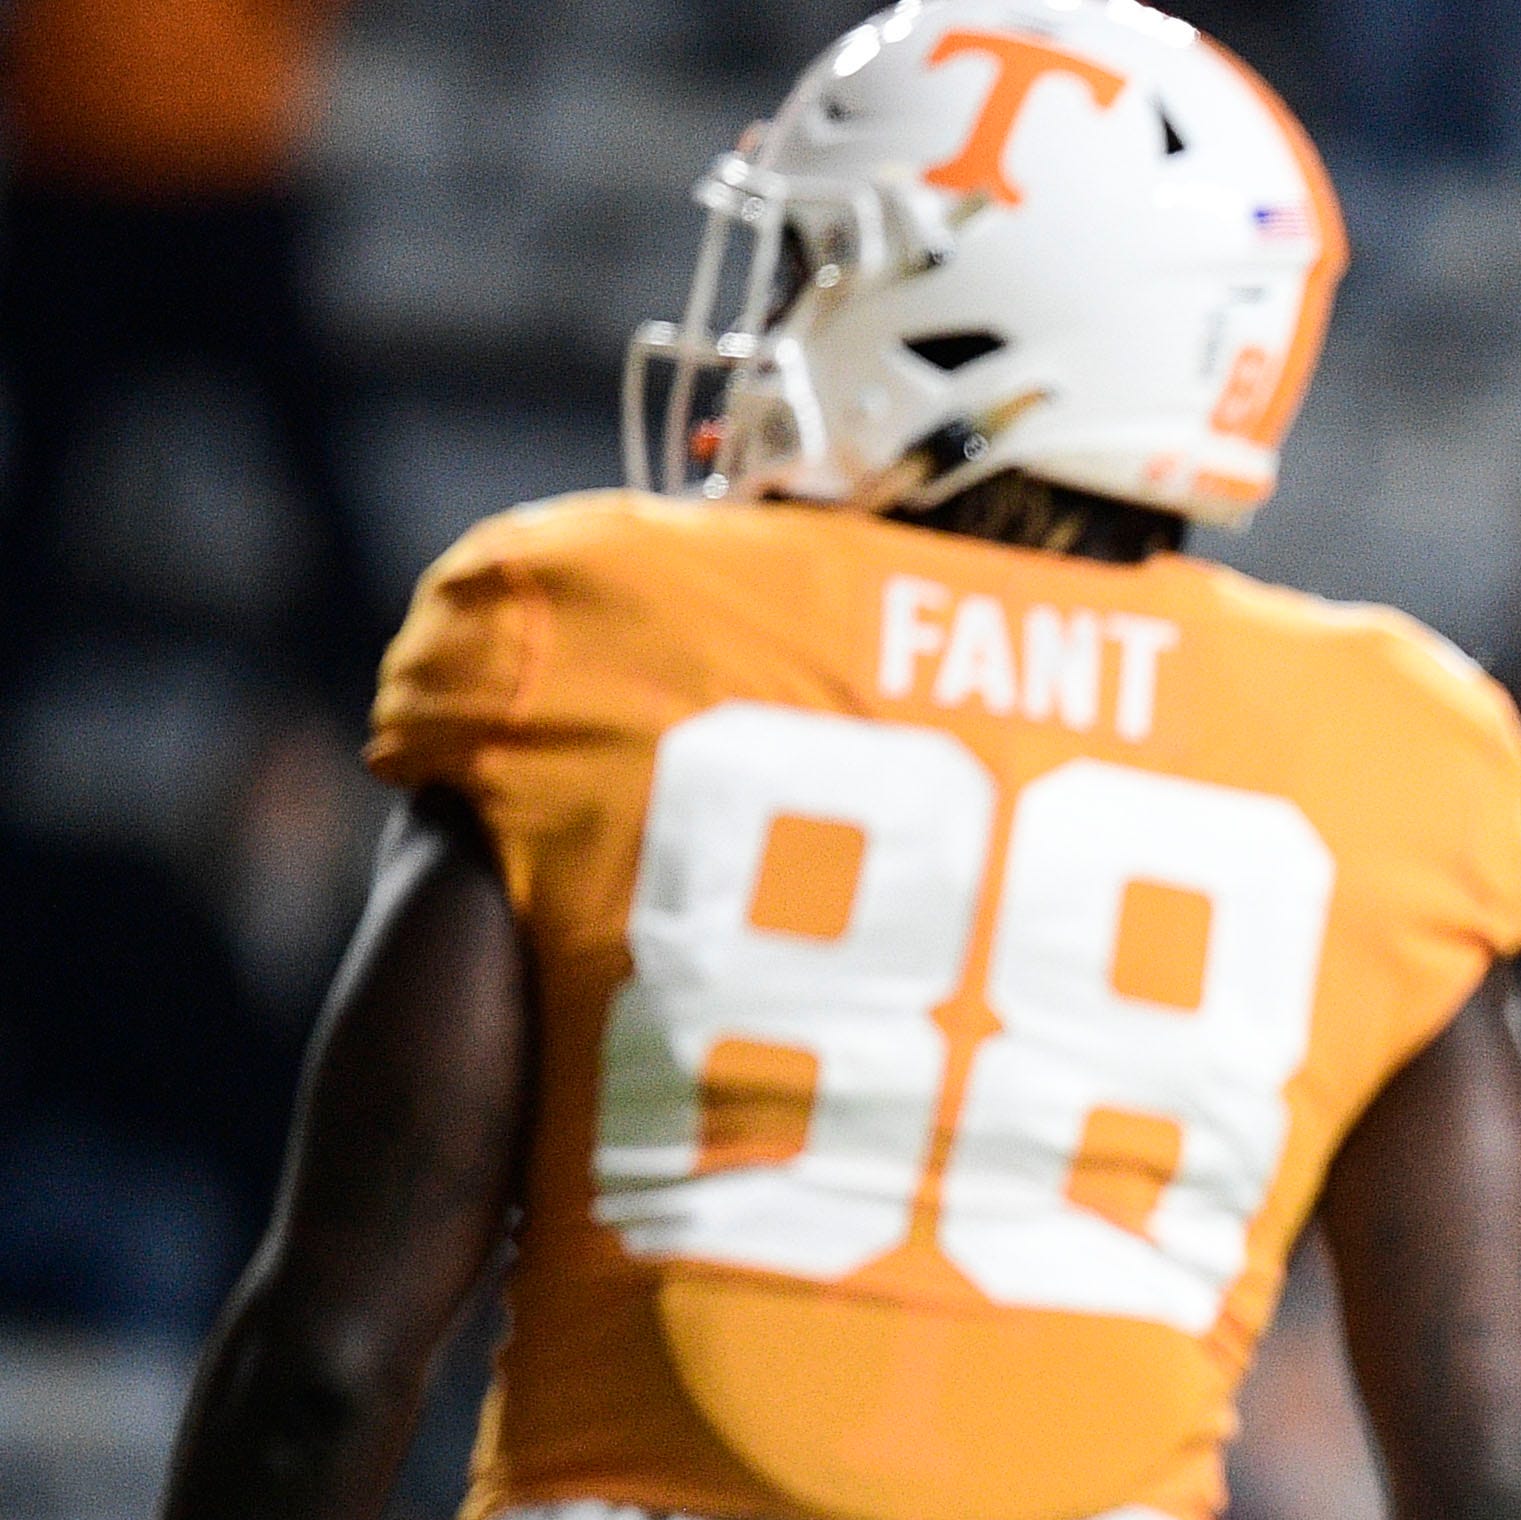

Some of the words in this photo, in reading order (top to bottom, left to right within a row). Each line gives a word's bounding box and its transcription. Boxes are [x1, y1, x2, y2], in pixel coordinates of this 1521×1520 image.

[923, 26, 1127, 205] T
[879, 573, 1179, 742] FANT
[591, 697, 1336, 1338] 88
